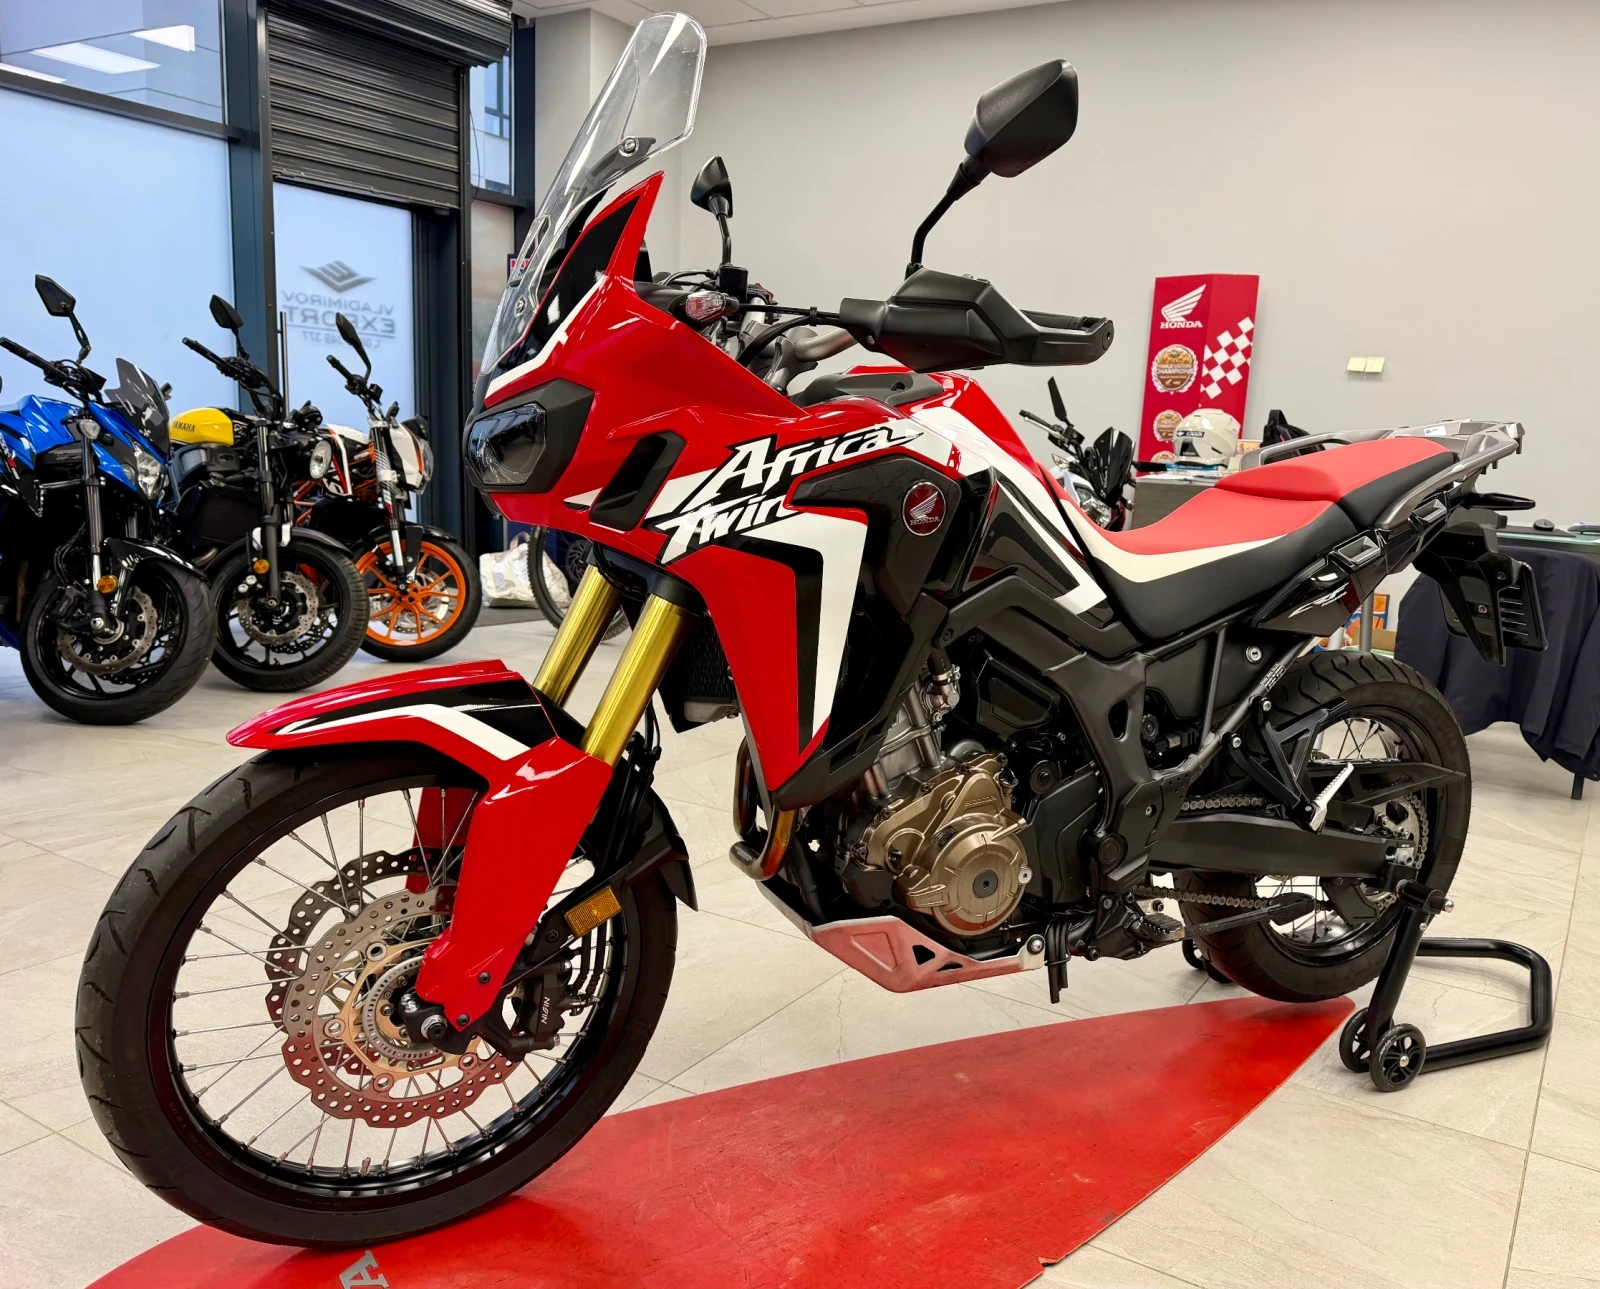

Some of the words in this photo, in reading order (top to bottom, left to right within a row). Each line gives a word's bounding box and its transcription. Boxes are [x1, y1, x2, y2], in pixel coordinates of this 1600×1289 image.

[1159, 320, 1203, 329] HONDA
[1155, 367, 1194, 375] CHAMPIONS
[173, 420, 196, 433] YAMAHA
[680, 425, 925, 514] Africa
[909, 516, 940, 526] HONDA
[655, 493, 799, 565] Twin
